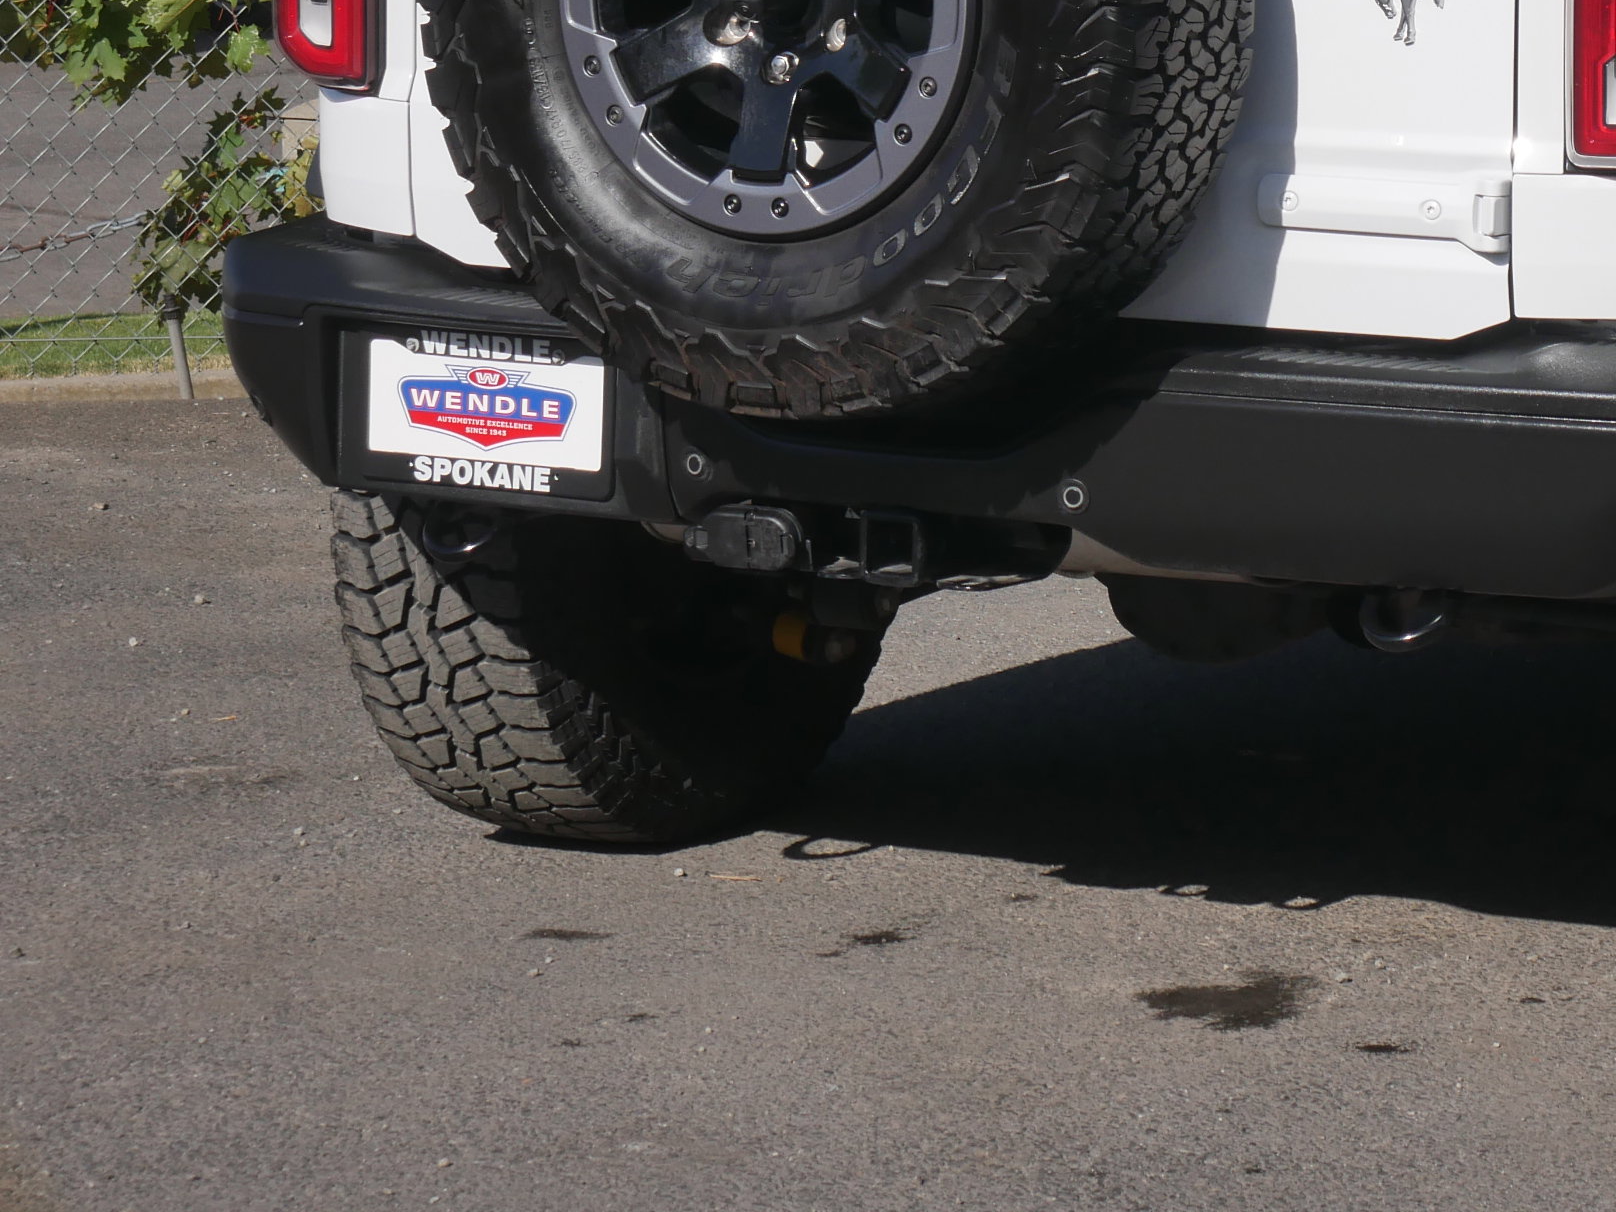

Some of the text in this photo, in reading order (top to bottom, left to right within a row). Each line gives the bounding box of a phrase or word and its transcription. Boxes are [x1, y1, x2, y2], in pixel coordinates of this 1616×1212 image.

[421, 330, 552, 364] WENDLE
[410, 388, 559, 419] WENDLE
[437, 416, 533, 430] AUTOMOTIVE EXCELLENCE
[465, 427, 488, 435] SINCE
[413, 455, 551, 493] SPOKANE
